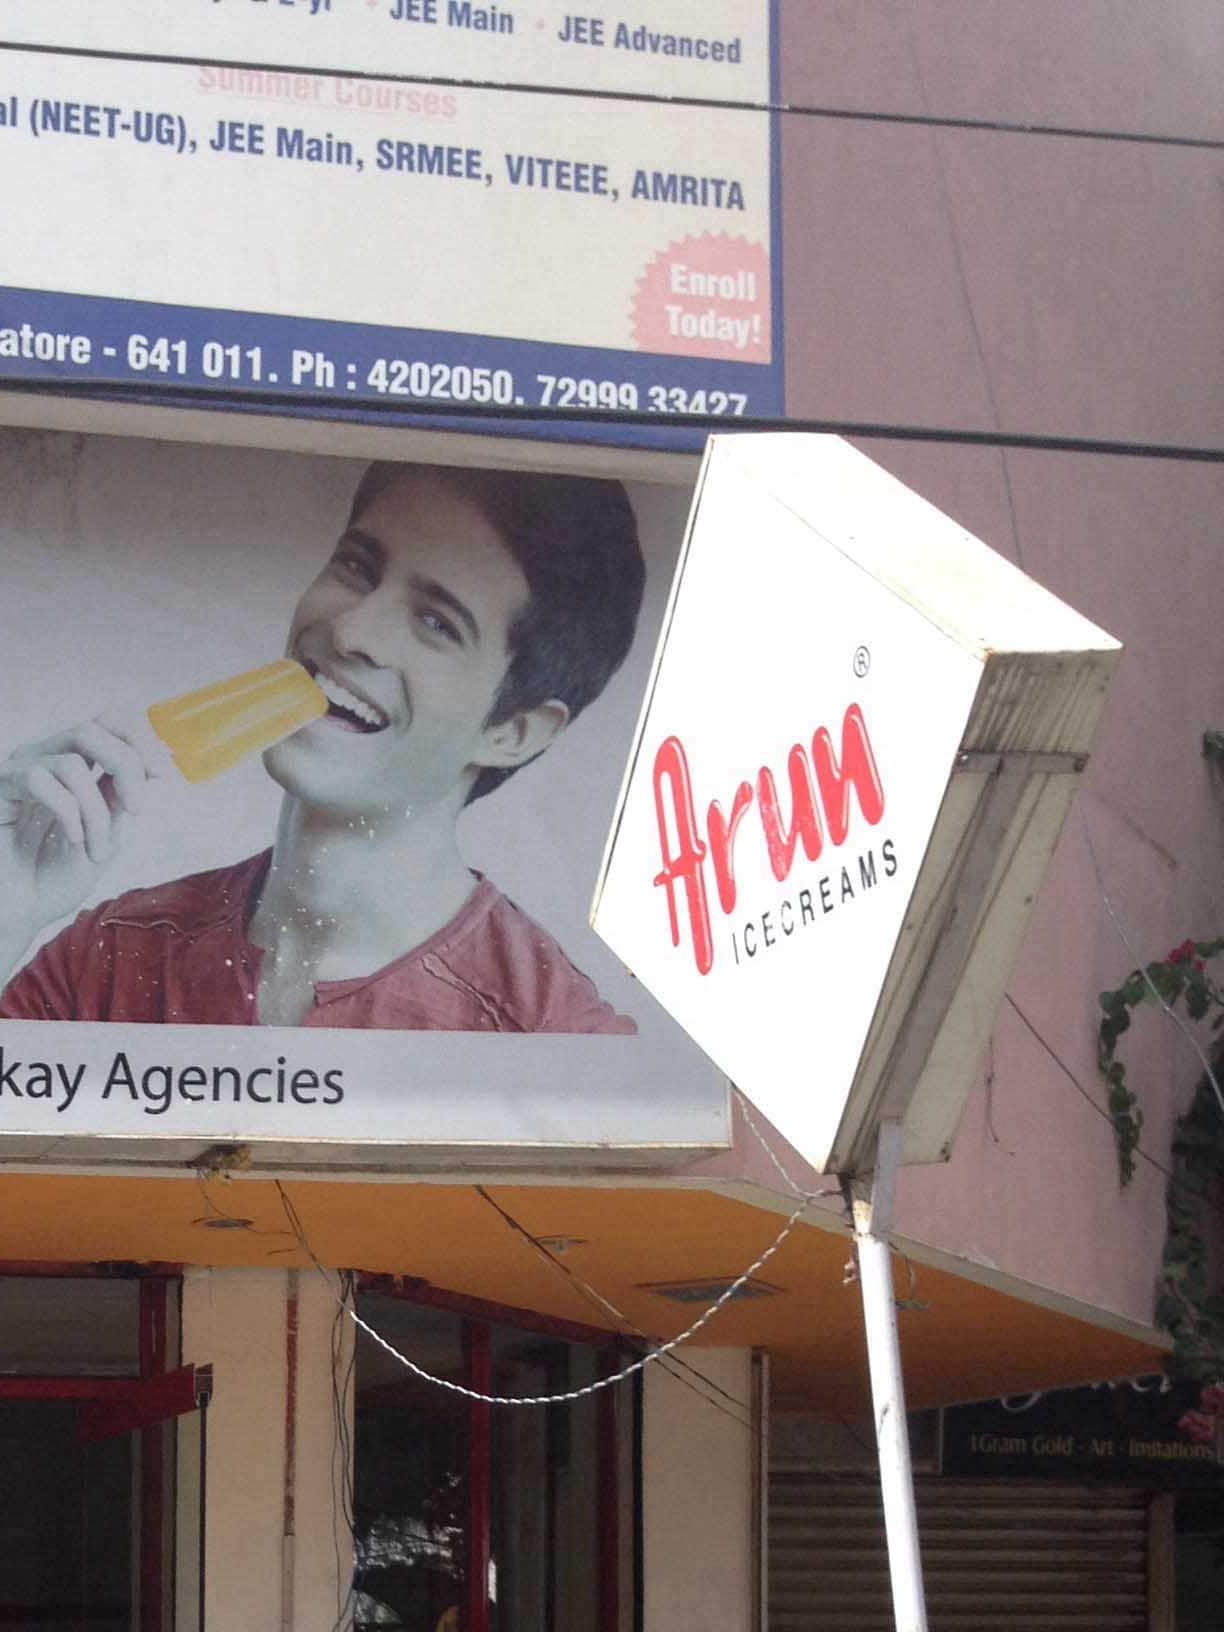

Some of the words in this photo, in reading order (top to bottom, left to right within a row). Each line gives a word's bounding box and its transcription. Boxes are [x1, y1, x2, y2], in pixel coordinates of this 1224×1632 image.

[390, 0, 438, 24] JEE
[447, 0, 514, 35] Main
[558, 15, 604, 48] JEE
[614, 22, 741, 65] Advanced
[335, 75, 457, 119] Courses
[29, 98, 198, 154] (NEET-UG),
[209, 120, 264, 155] JEE
[276, 127, 364, 172] Main,
[376, 138, 493, 187] SRMEE,
[505, 153, 619, 202] VITEEE,
[631, 169, 745, 212] AMRITA
[670, 263, 757, 302] Enroll
[664, 303, 761, 348] Today!
[127, 333, 188, 375] 641
[202, 341, 279, 384] 011.
[291, 349, 335, 389] Ph
[367, 357, 525, 408] 4202050.
[536, 373, 638, 411] 72999
[653, 702, 885, 976] Arun
[732, 838, 898, 965] ICECREAMS
[101, 1052, 345, 1115] Agencies
